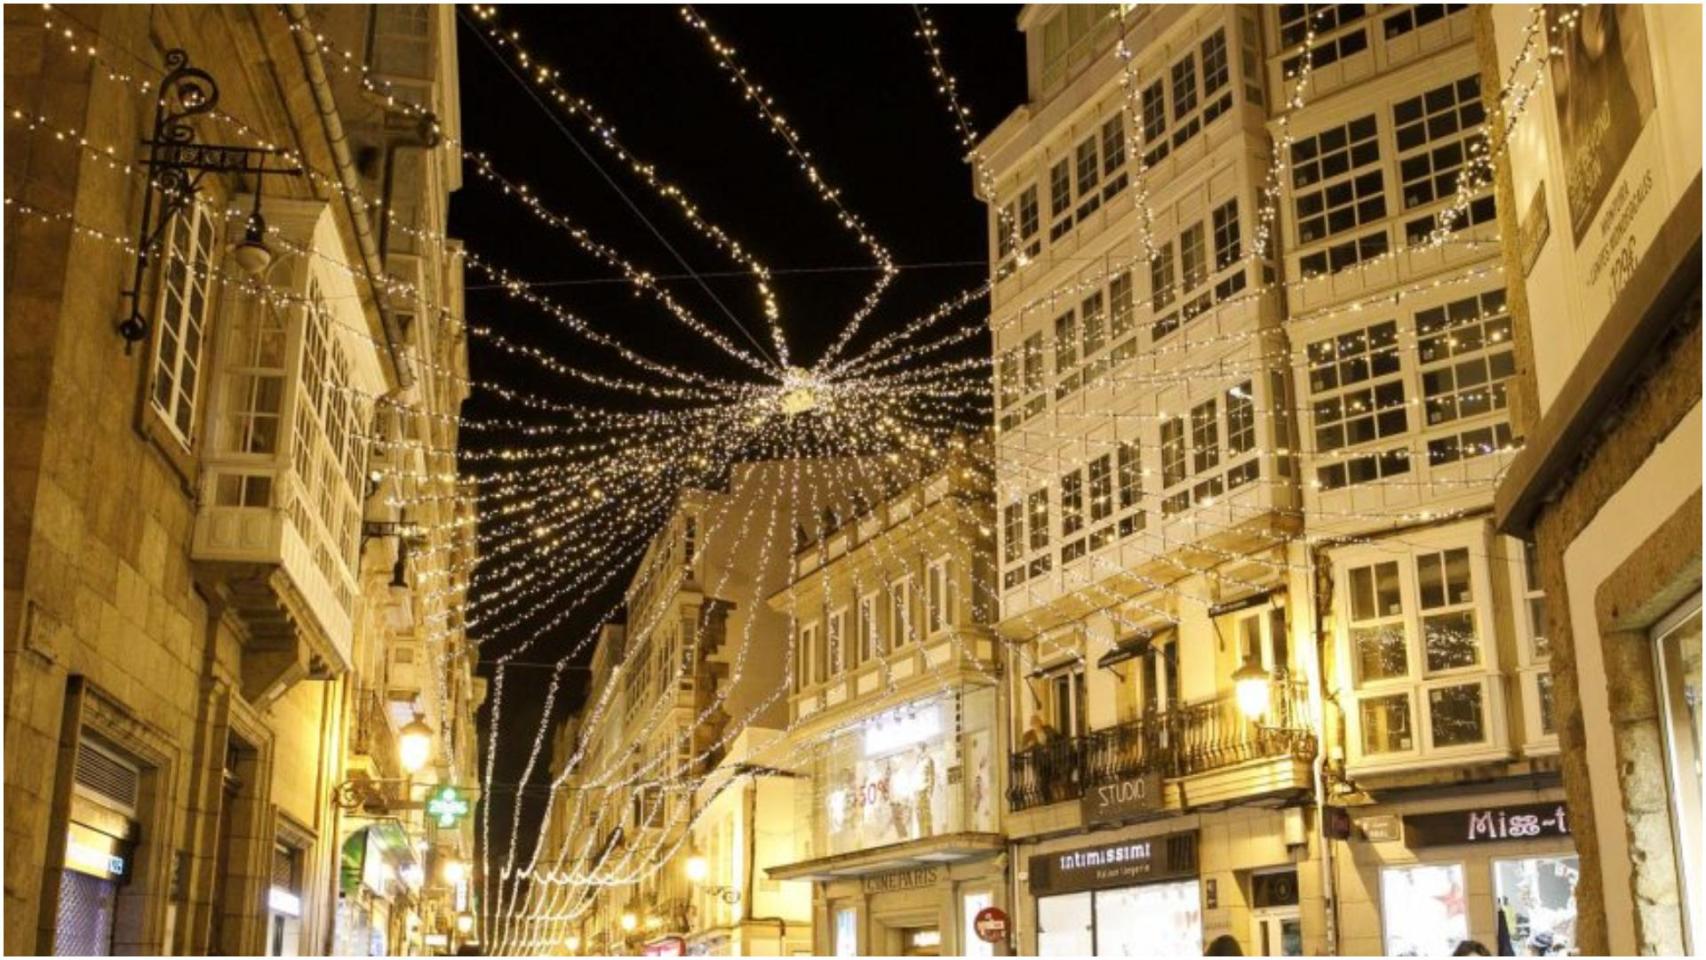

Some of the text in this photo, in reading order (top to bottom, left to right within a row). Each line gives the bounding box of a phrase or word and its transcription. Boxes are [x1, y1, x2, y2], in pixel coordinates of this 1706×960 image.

[1098, 778, 1145, 807] STUDIO
[1467, 805, 1572, 840] Miss-t
[1061, 843, 1151, 869] intimissimi
[898, 867, 937, 888] PARIS
